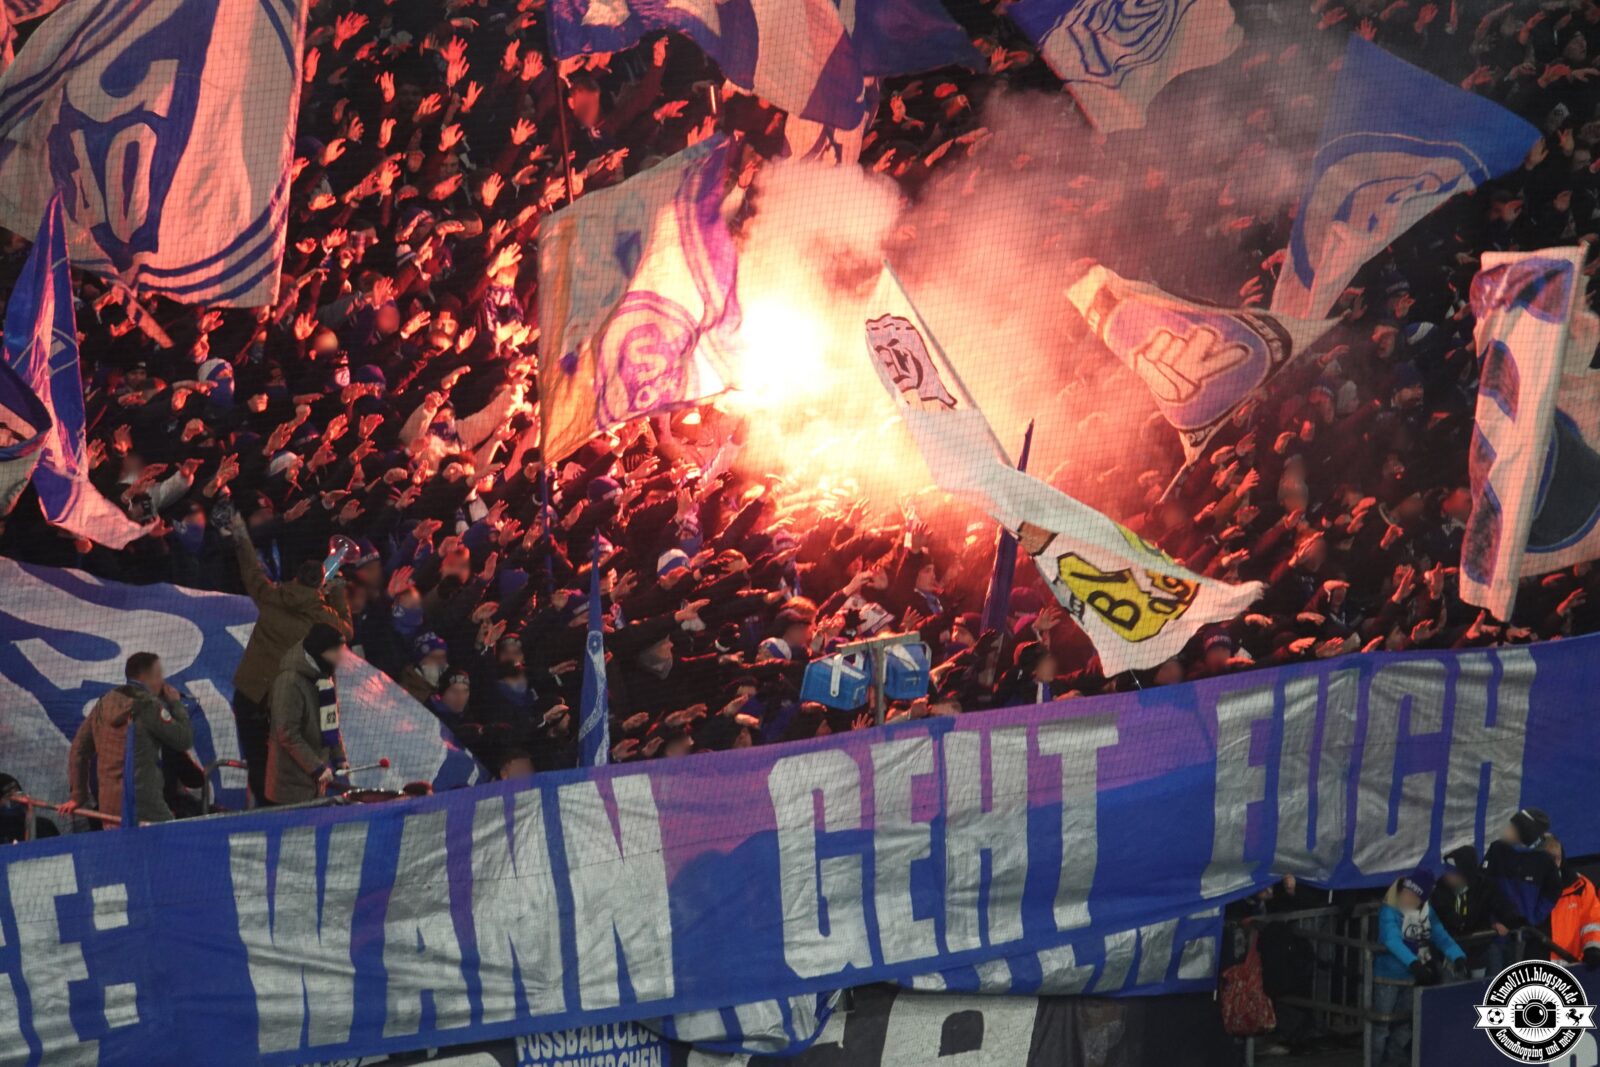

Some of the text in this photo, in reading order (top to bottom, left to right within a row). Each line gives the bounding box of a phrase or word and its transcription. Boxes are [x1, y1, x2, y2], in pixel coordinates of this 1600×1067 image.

[0, 648, 1537, 1067] E: WANN GEHT EUCH
